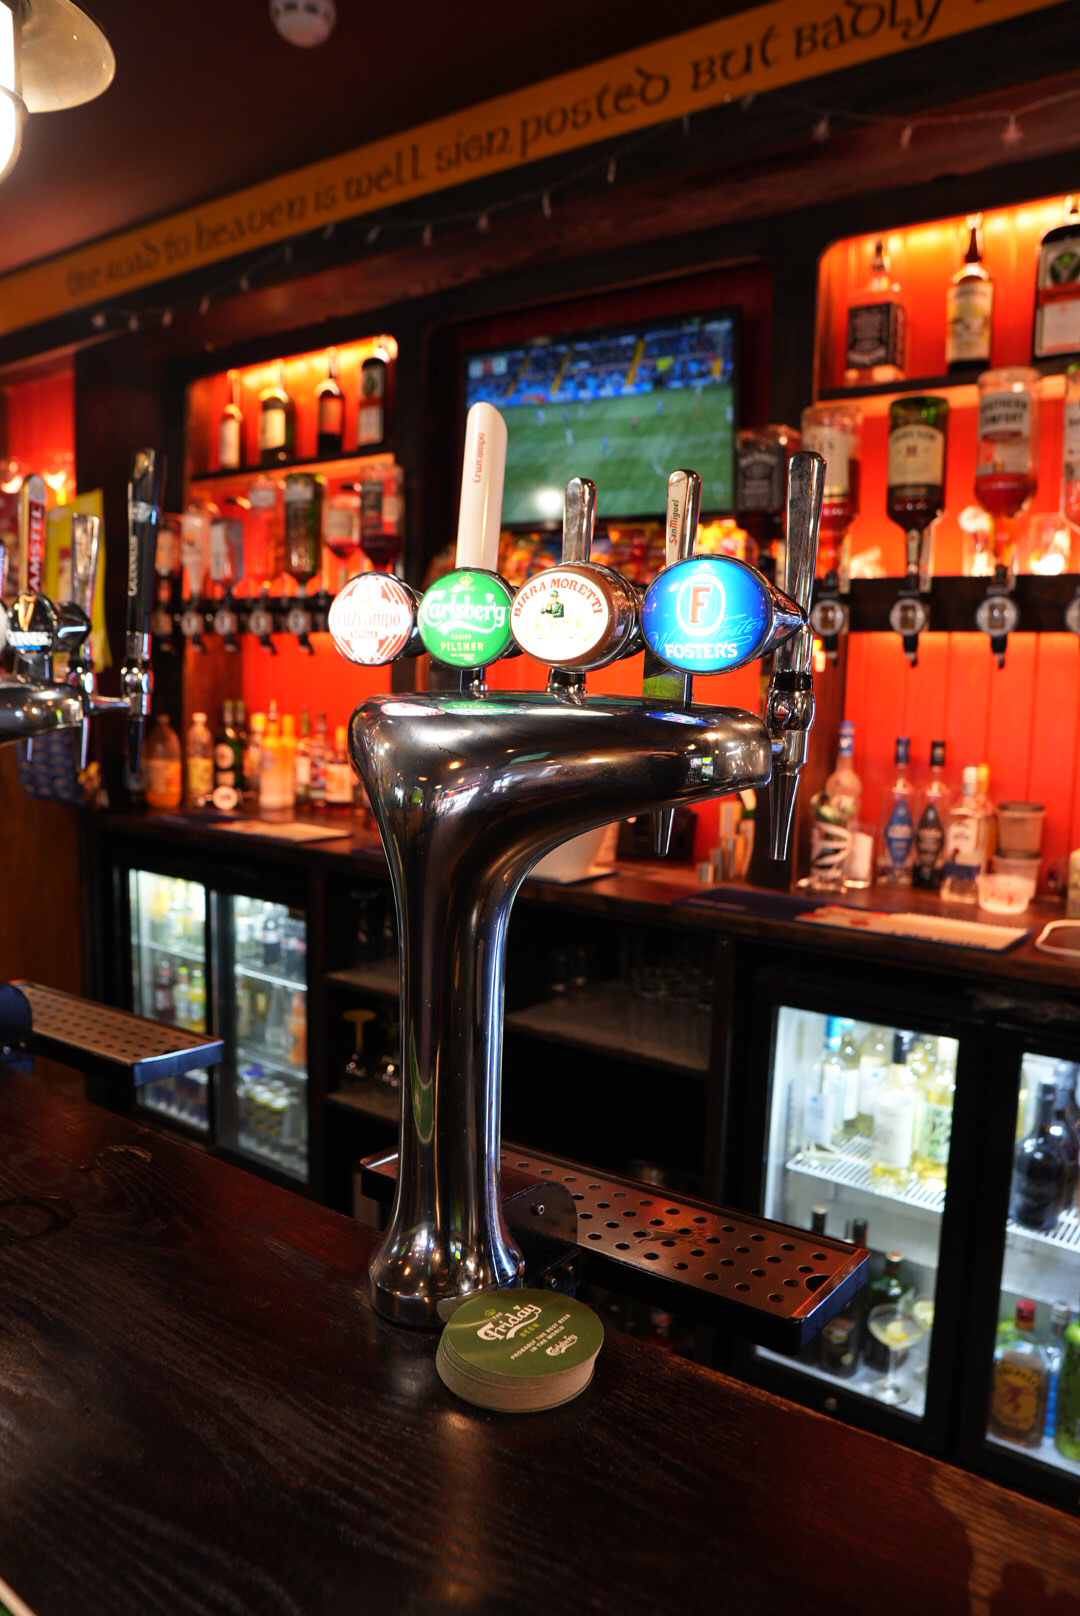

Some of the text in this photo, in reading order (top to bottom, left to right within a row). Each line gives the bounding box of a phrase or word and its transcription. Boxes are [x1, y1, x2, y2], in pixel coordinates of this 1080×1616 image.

[313, 178, 338, 213] is
[343, 143, 426, 200] well
[520, 66, 670, 159] posted
[29, 506, 42, 592] AMSTEL
[422, 590, 506, 633] Carlsberg
[514, 578, 603, 618] BIRRA MORETTI
[690, 586, 712, 624] F
[440, 642, 484, 651] PILSNER
[665, 642, 738, 658] FOSTER'S
[520, 1323, 540, 1338] BEER
